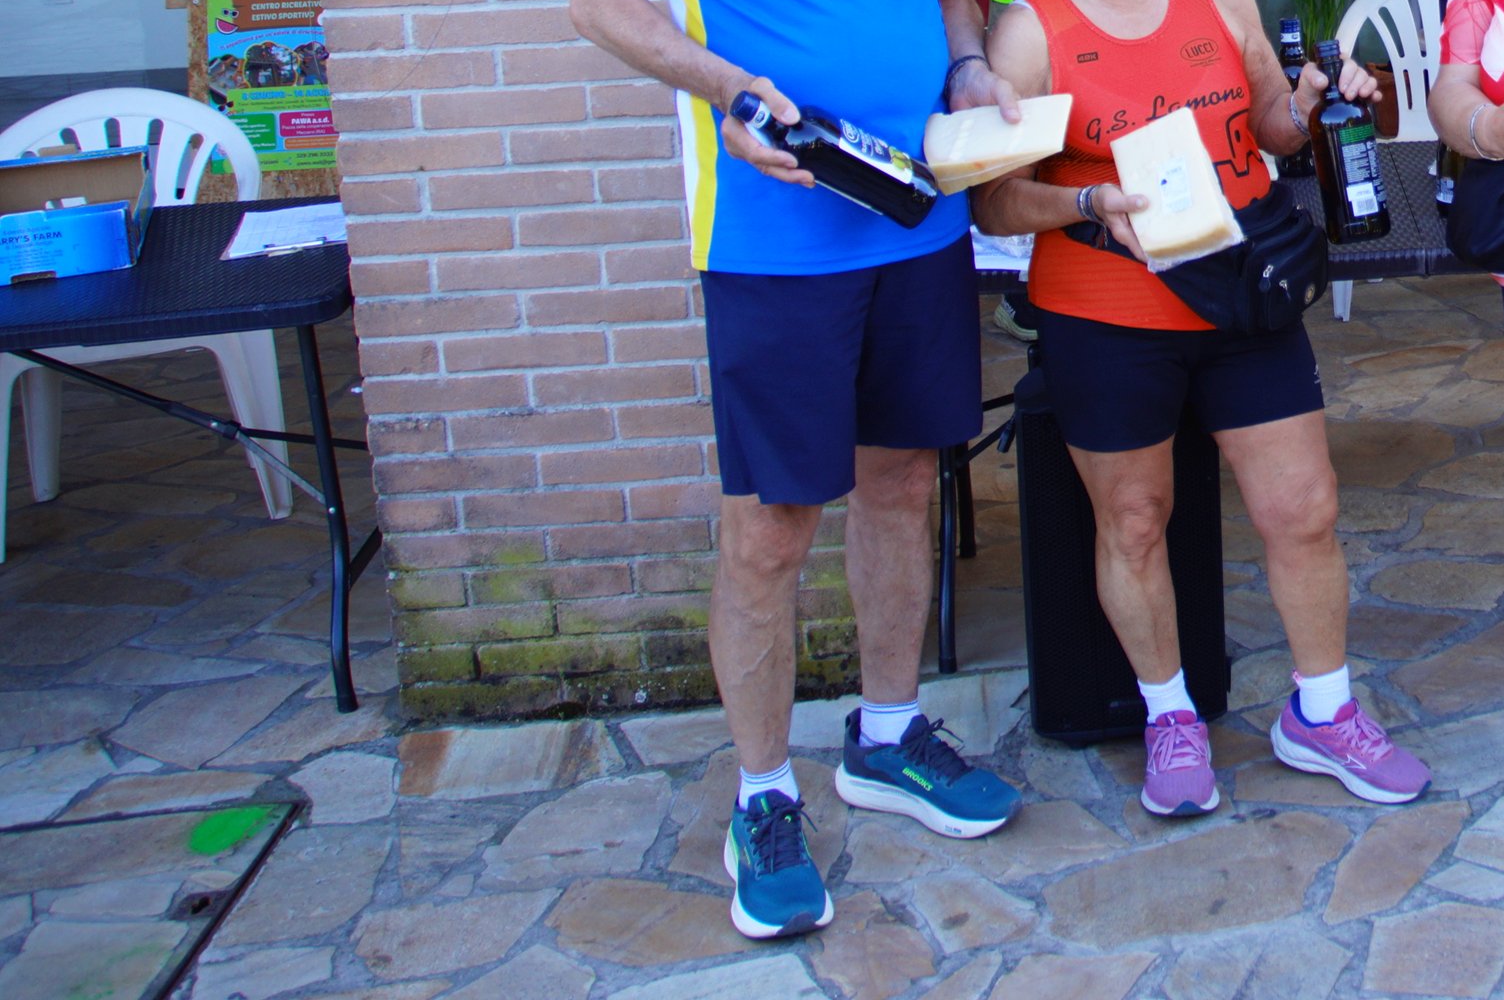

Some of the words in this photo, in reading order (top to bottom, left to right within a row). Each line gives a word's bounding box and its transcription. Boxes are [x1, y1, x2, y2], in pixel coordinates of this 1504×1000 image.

[251, 1, 280, 11] CENTRO
[279, 10, 315, 20] SPORTIVO
[1185, 42, 1214, 57] LUCCI
[1086, 110, 1136, 144] G.S.
[33, 231, 62, 241] FARM
[902, 766, 934, 792] BROOKS
